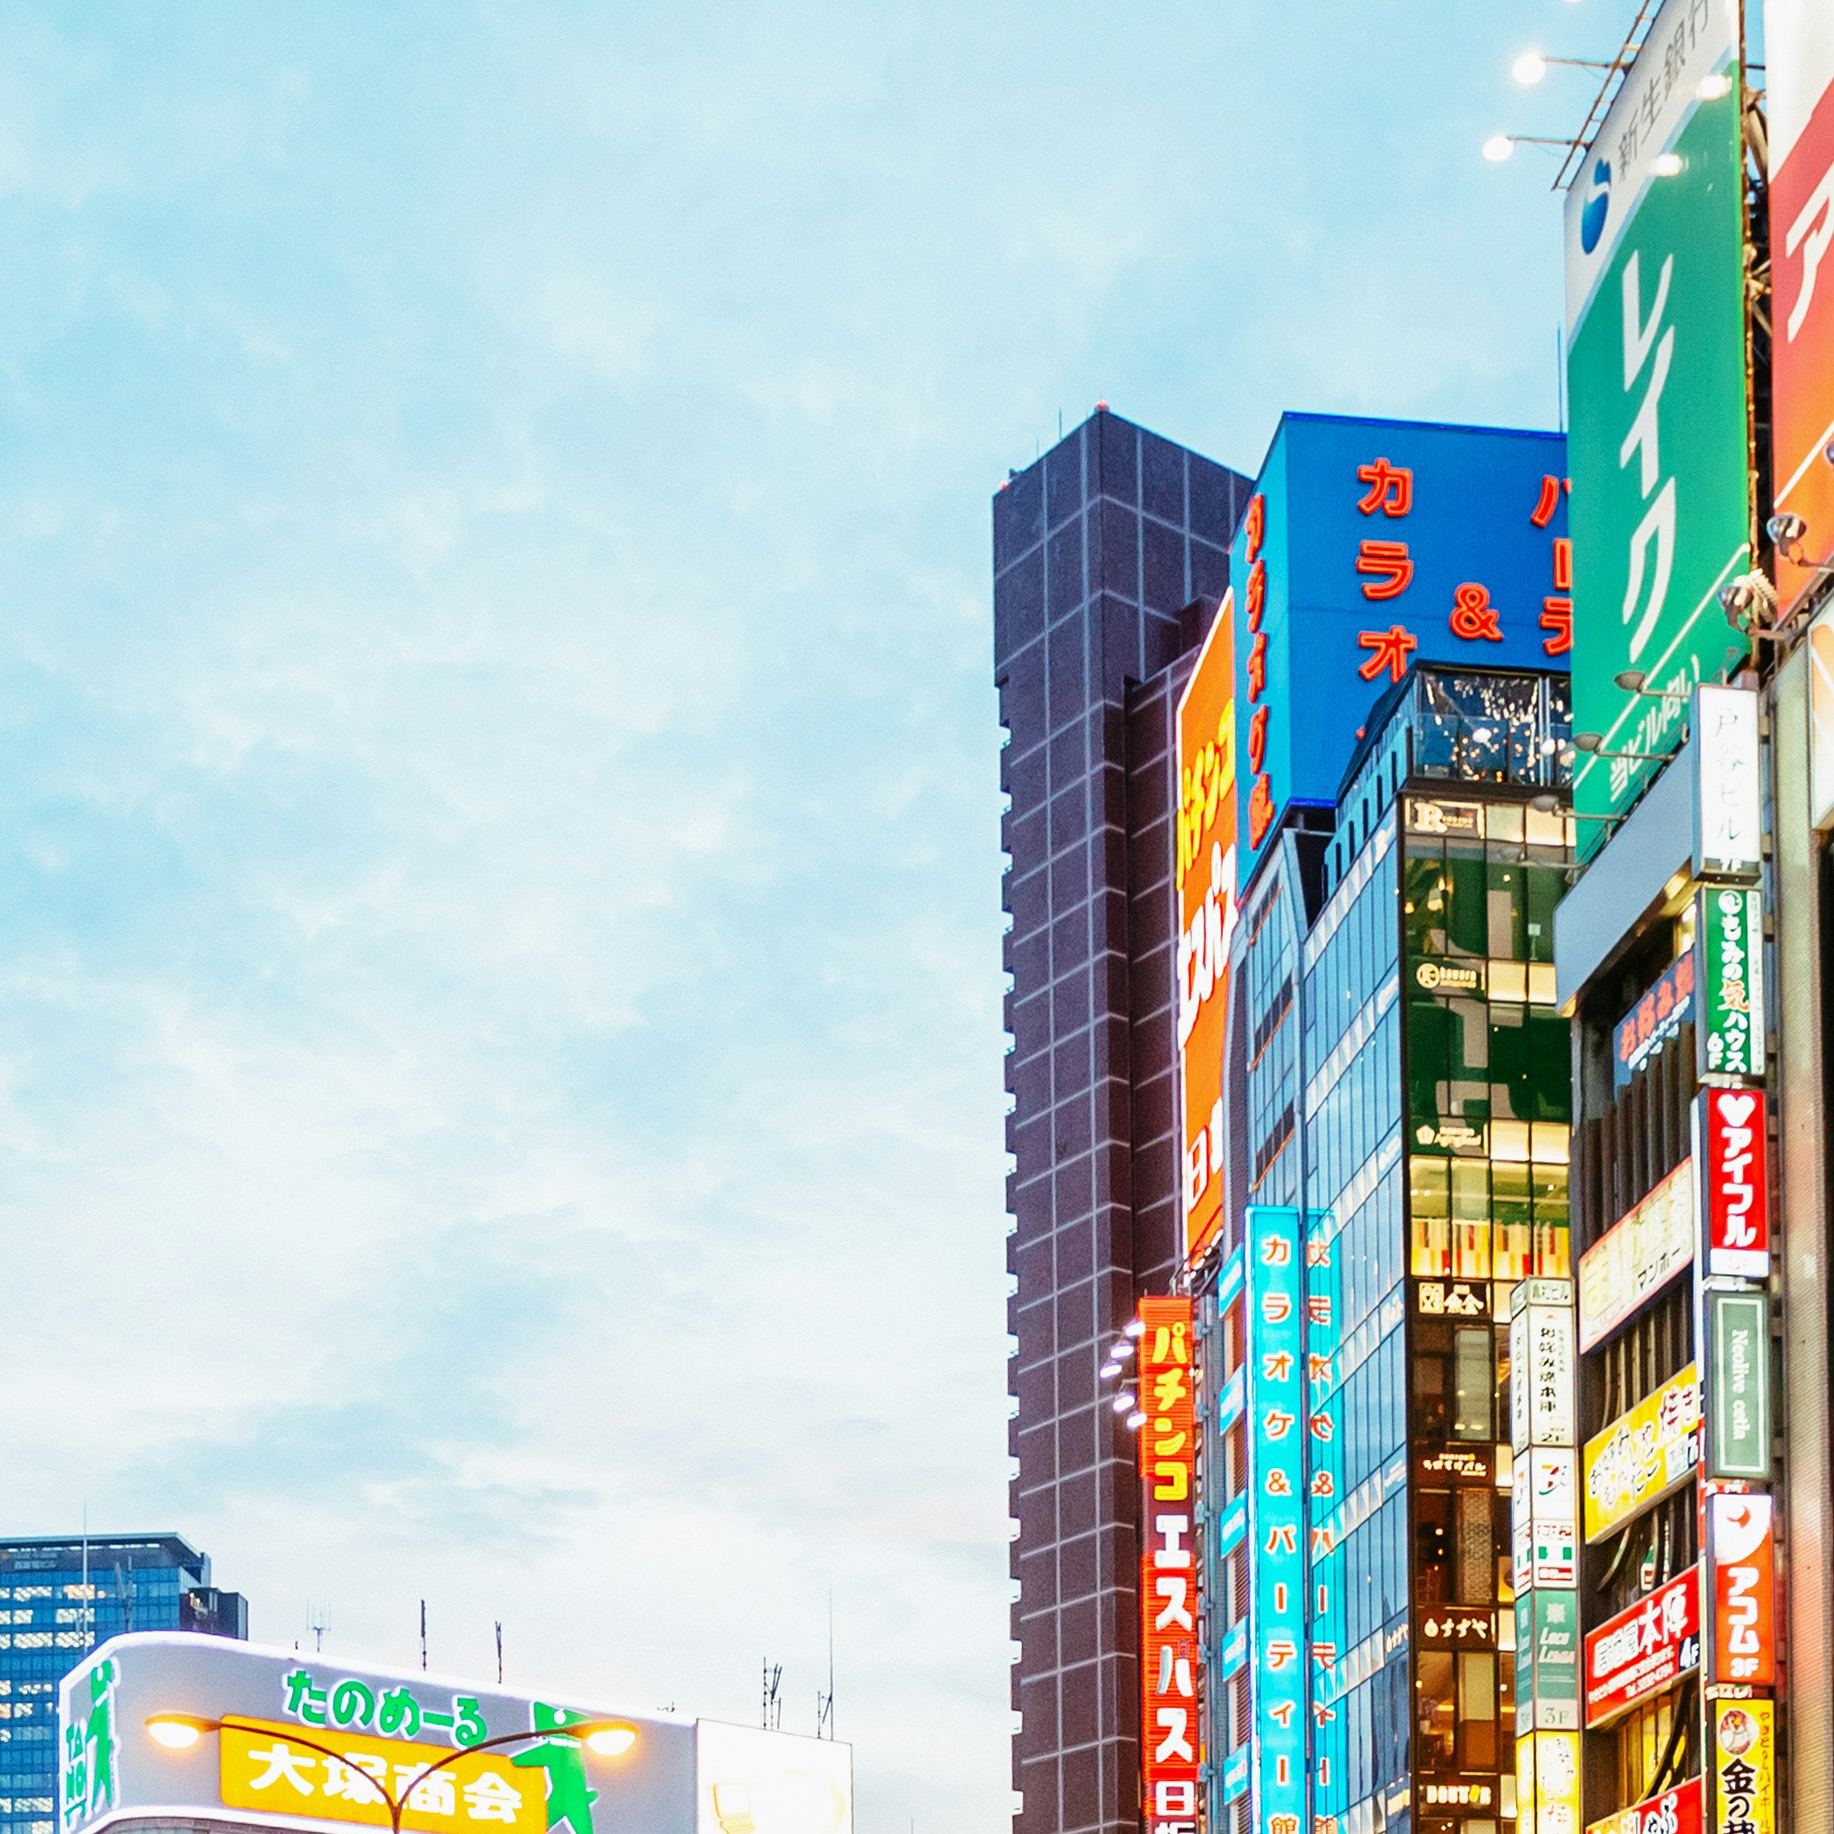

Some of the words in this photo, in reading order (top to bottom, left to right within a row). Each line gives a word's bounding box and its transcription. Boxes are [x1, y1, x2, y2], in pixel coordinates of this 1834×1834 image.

[1618, 247, 1679, 662] レイク
[1717, 916, 1750, 1074] もみの気ハウス
[1721, 1127, 1757, 1249] アイフル
[1151, 1320, 1190, 1503] パチンコ
[1153, 1511, 1194, 1766] エスパス
[1726, 1568, 1760, 1653] アコム
[285, 1670, 488, 1748] たのめーる
[1729, 1657, 1760, 1679] 3F
[1544, 1706, 1569, 1724] 3F
[248, 1744, 523, 1823] 大塚商会
[1425, 1784, 1492, 1805] DOUTOR
